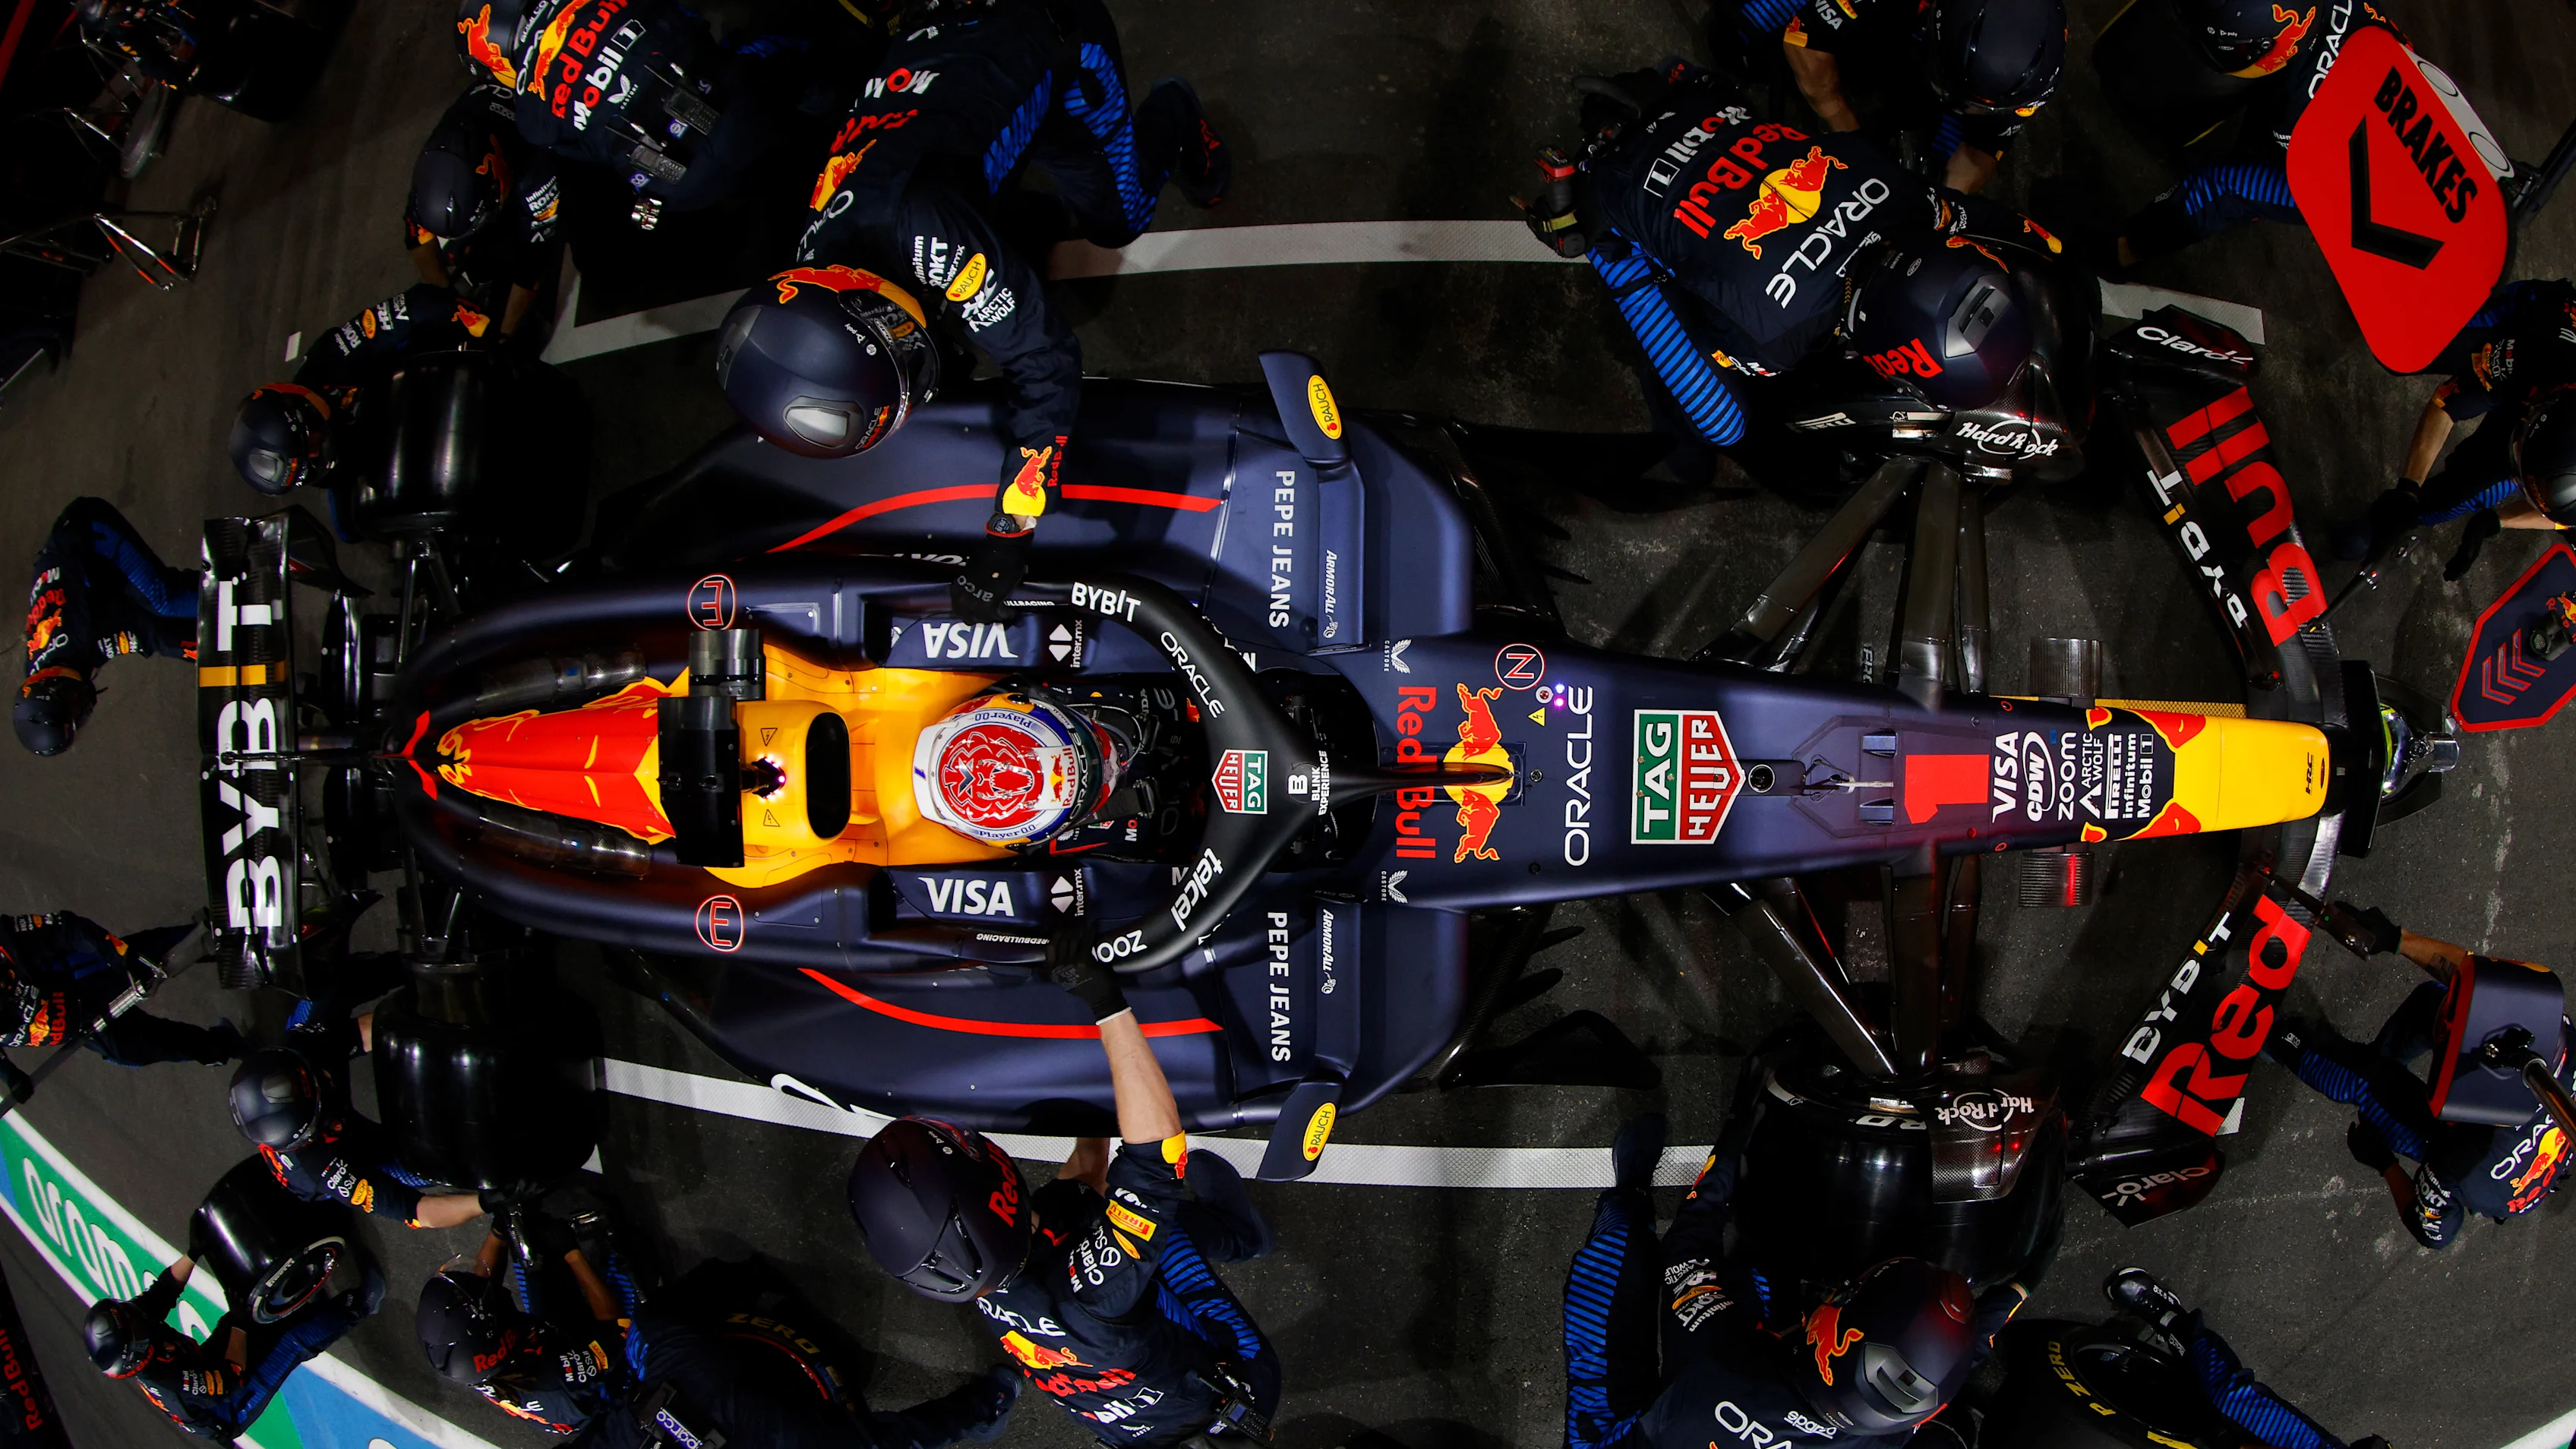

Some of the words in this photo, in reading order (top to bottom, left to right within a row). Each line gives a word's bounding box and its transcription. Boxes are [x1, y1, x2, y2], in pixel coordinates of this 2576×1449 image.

[2307, 0, 2353, 99] ORACL
[573, 46, 624, 131] Mobil
[1664, 105, 1754, 164] Mobil
[1728, 122, 1812, 171] Red
[2373, 66, 2479, 224] BRAKES
[1673, 156, 1755, 240] Bull
[1764, 178, 1891, 310] ORACLE
[955, 259, 983, 296] RAUCH
[977, 286, 1014, 322] ARCTIC
[990, 298, 1017, 324] WOLF
[2136, 326, 2237, 363] Claro
[1313, 383, 1334, 423] RAUCH
[1955, 421, 2017, 447] Hard
[2016, 431, 2060, 458] Rock
[1046, 460, 1062, 488] Red
[1273, 470, 1296, 538] PEPE
[2166, 385, 2329, 648] Bull
[956, 574, 994, 603] arco
[1002, 599, 1056, 608] ULLRACING
[1071, 581, 1141, 623] BYBIT
[1268, 544, 1295, 630] JEANS
[921, 621, 1019, 659] VISA
[1069, 618, 1084, 669] inter.mx
[1160, 630, 1226, 719] ORACLE
[990, 712, 1034, 729] Player
[1394, 685, 1438, 765] Red
[198, 580, 284, 928] BYBIT
[1062, 747, 1075, 778] Bull
[1069, 731, 1089, 823] ORACLE
[1564, 684, 1595, 867] ORACLE
[1643, 720, 1673, 835] TAG
[1688, 718, 1721, 837] HEUER
[1992, 731, 2019, 824] VISA
[2081, 731, 2094, 787] ARCTIC
[2092, 736, 2105, 781] WOLF
[2104, 733, 2123, 819] PIRELLI
[2123, 732, 2138, 819] infinitum
[2306, 751, 2315, 796] HRC
[1063, 778, 1075, 807] Red
[1217, 753, 1239, 811] HEUER
[1246, 756, 1264, 809] TAG
[1311, 766, 1321, 803] BLINK
[1318, 750, 1330, 816] EXPERIENCE
[1904, 753, 1990, 825] 1
[2026, 752, 2046, 823] CDW
[2136, 756, 2155, 819] Mobil
[979, 828, 1022, 840] Player
[1394, 784, 1437, 860] Bull
[917, 876, 1015, 917] VISA
[1075, 868, 1085, 917] inter.mx
[1170, 847, 1224, 933] telcel
[1379, 870, 1387, 903] CASTORE
[1092, 928, 1148, 964] zoo
[1267, 911, 1290, 978] PEPE
[2122, 911, 2232, 1065] BYBIT
[1269, 983, 1292, 1062] JEANS
[2140, 893, 2312, 1138] Red
[2287, 1031, 2302, 1048] arco
[1311, 1109, 1333, 1148] RAUCH
[1855, 1114, 1928, 1131] RO
[1934, 1102, 1987, 1125] Rock
[1987, 1097, 2035, 1119] Hard
[326, 1163, 348, 1191] Claro
[987, 1153, 1020, 1229] Red
[2110, 1166, 2211, 1201] Claro
[22, 1157, 213, 1346] aram
[1078, 1236, 1105, 1286] Claro
[1664, 1261, 1689, 1278] WOLF
[725, 1312, 821, 1354] ZERO
[975, 1295, 1067, 1337] RACLE
[1688, 1299, 1735, 1333] infinitum
[473, 1337, 509, 1374] Red
[559, 1354, 574, 1383] Mobil
[575, 1352, 588, 1384] Claro
[2047, 1340, 2091, 1397] ZERO
[9, 1381, 44, 1432] Red
[655, 1409, 702, 1449] parco
[1783, 1410, 1839, 1440] sparco
[2089, 1402, 2117, 1416] P
